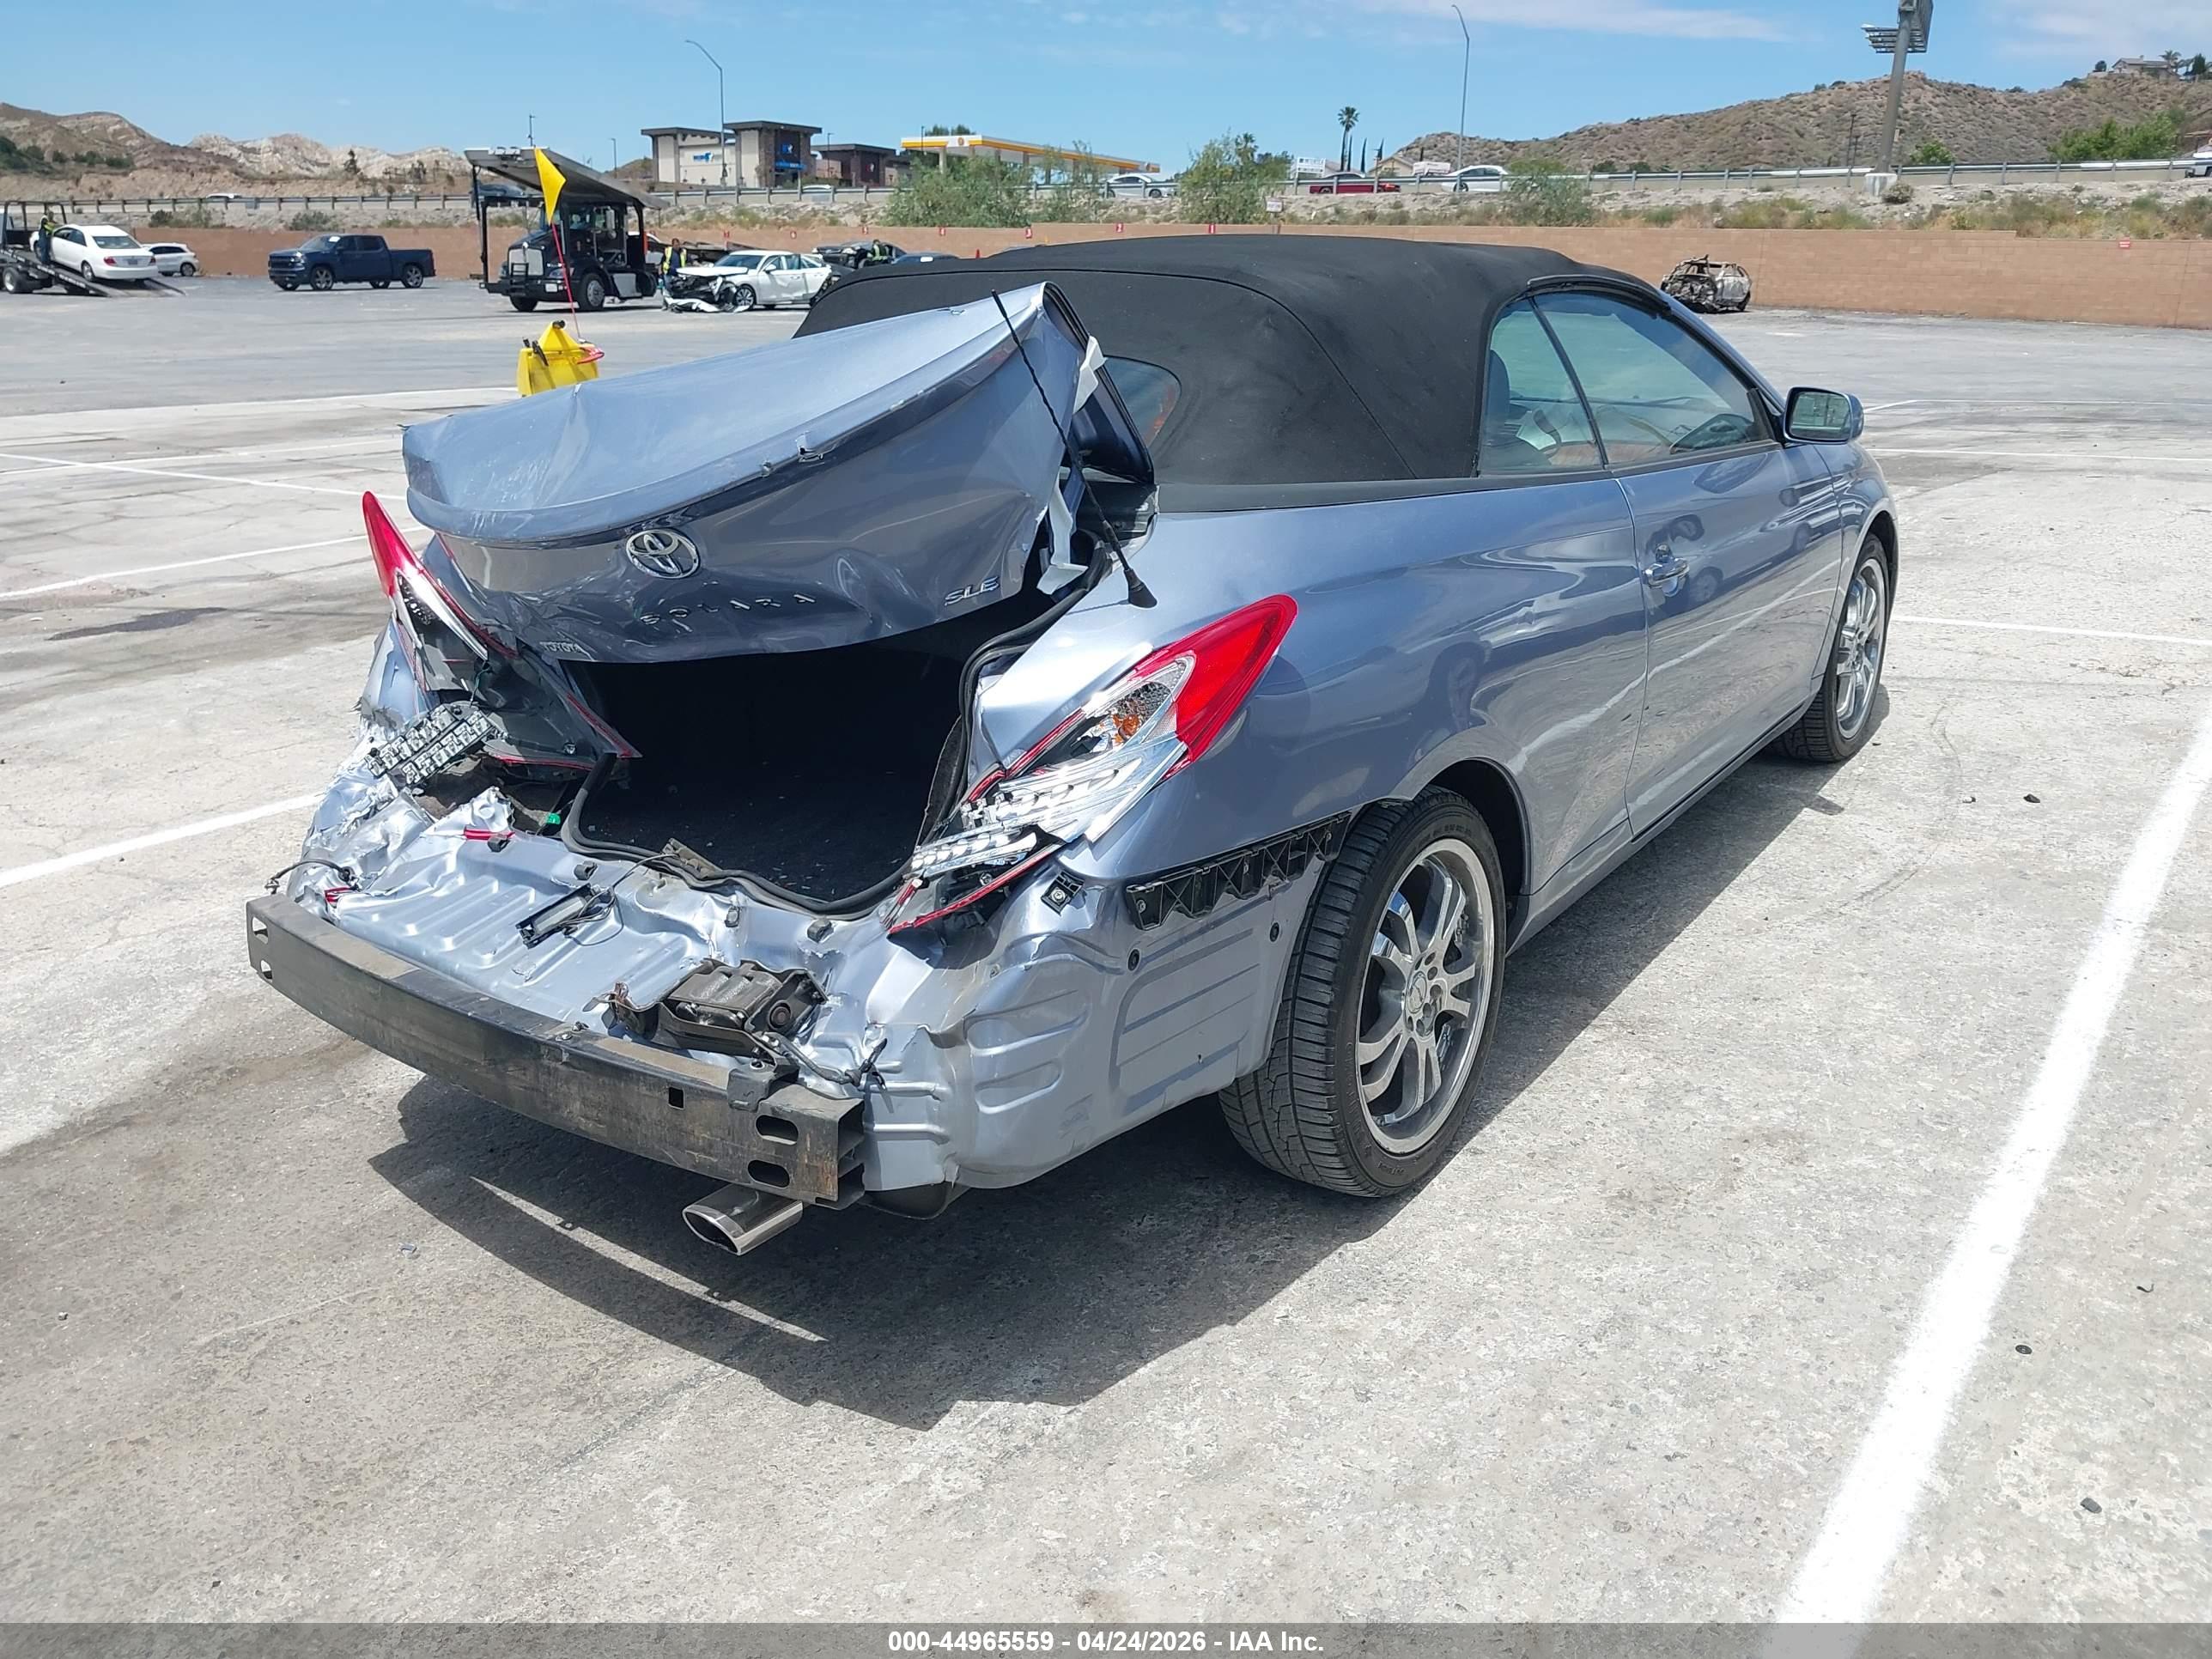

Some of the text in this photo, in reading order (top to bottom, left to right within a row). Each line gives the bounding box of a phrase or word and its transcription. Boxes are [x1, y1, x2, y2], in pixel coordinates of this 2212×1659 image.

[944, 576, 1000, 606] SLE
[640, 593, 816, 625] SOLARA
[539, 641, 587, 653] TOYOTA
